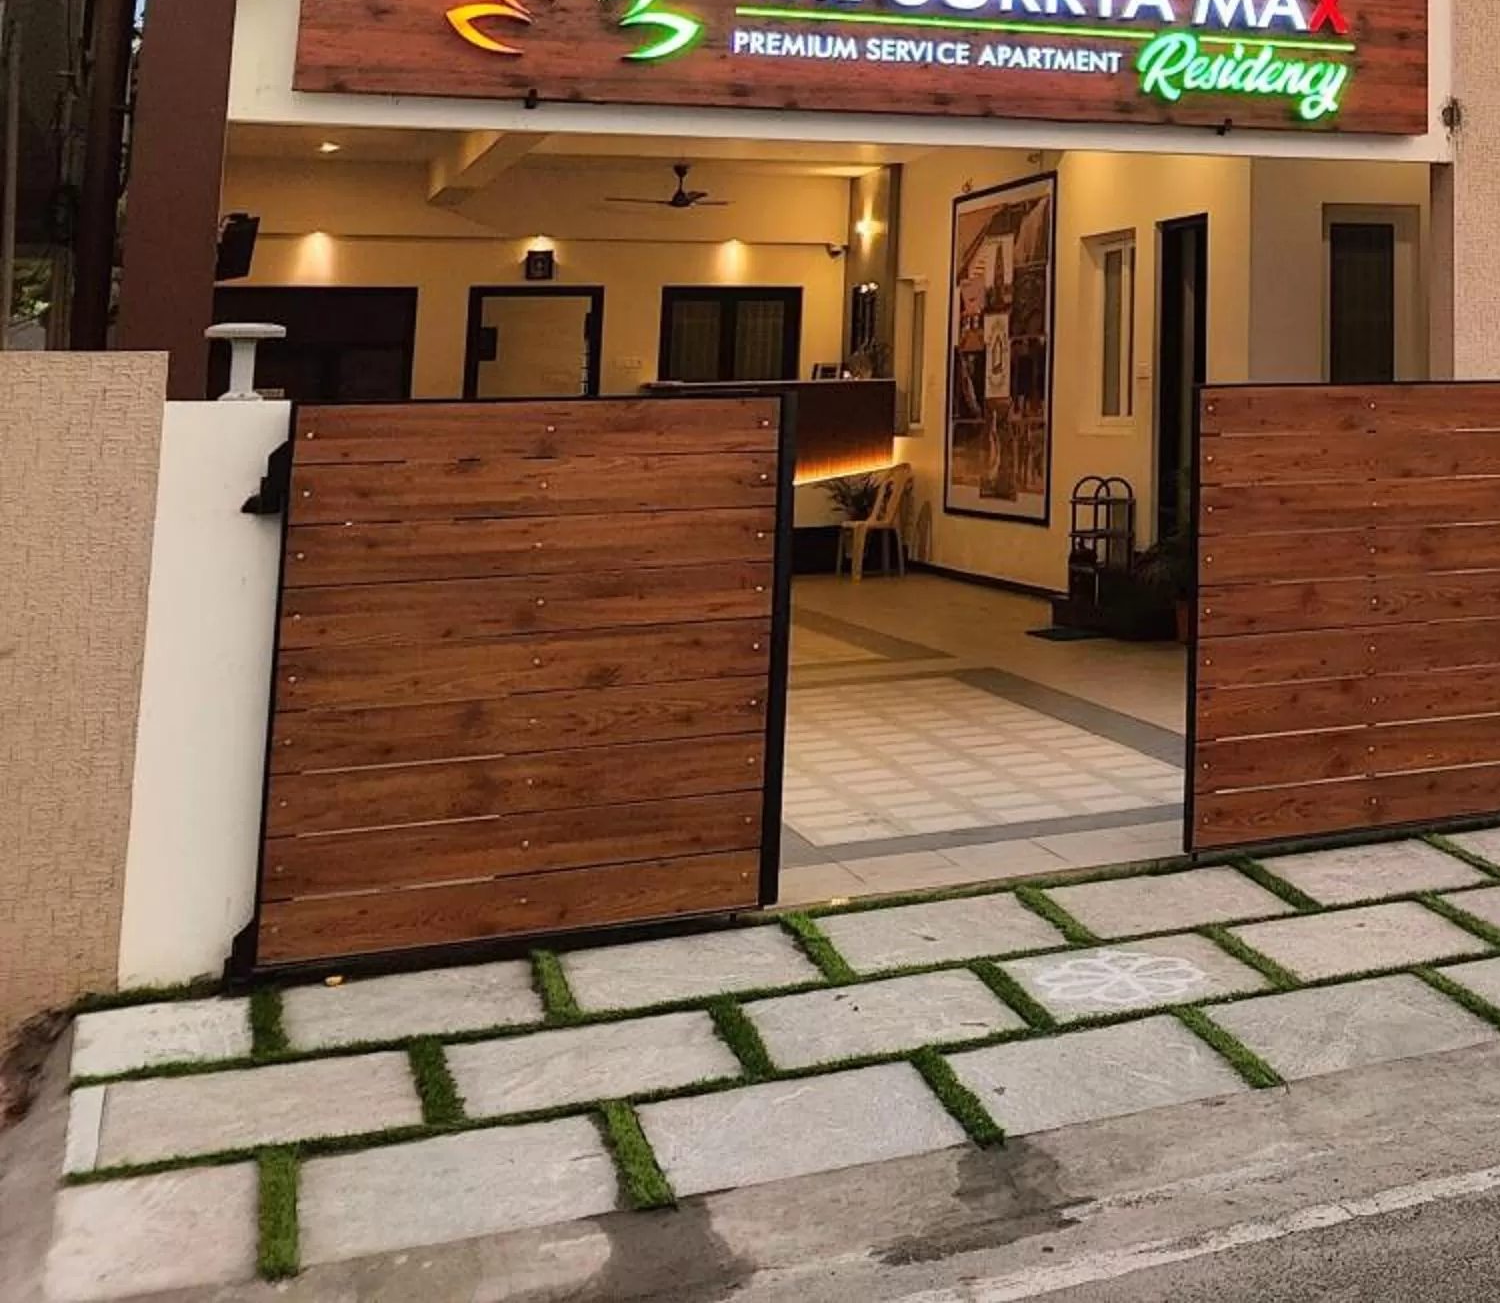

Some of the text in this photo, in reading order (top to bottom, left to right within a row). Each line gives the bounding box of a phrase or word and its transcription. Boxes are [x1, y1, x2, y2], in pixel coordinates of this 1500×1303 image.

[732, 32, 1123, 74] PREMIUM SERVICE APARTMENT
[1136, 31, 1350, 120] Residency
